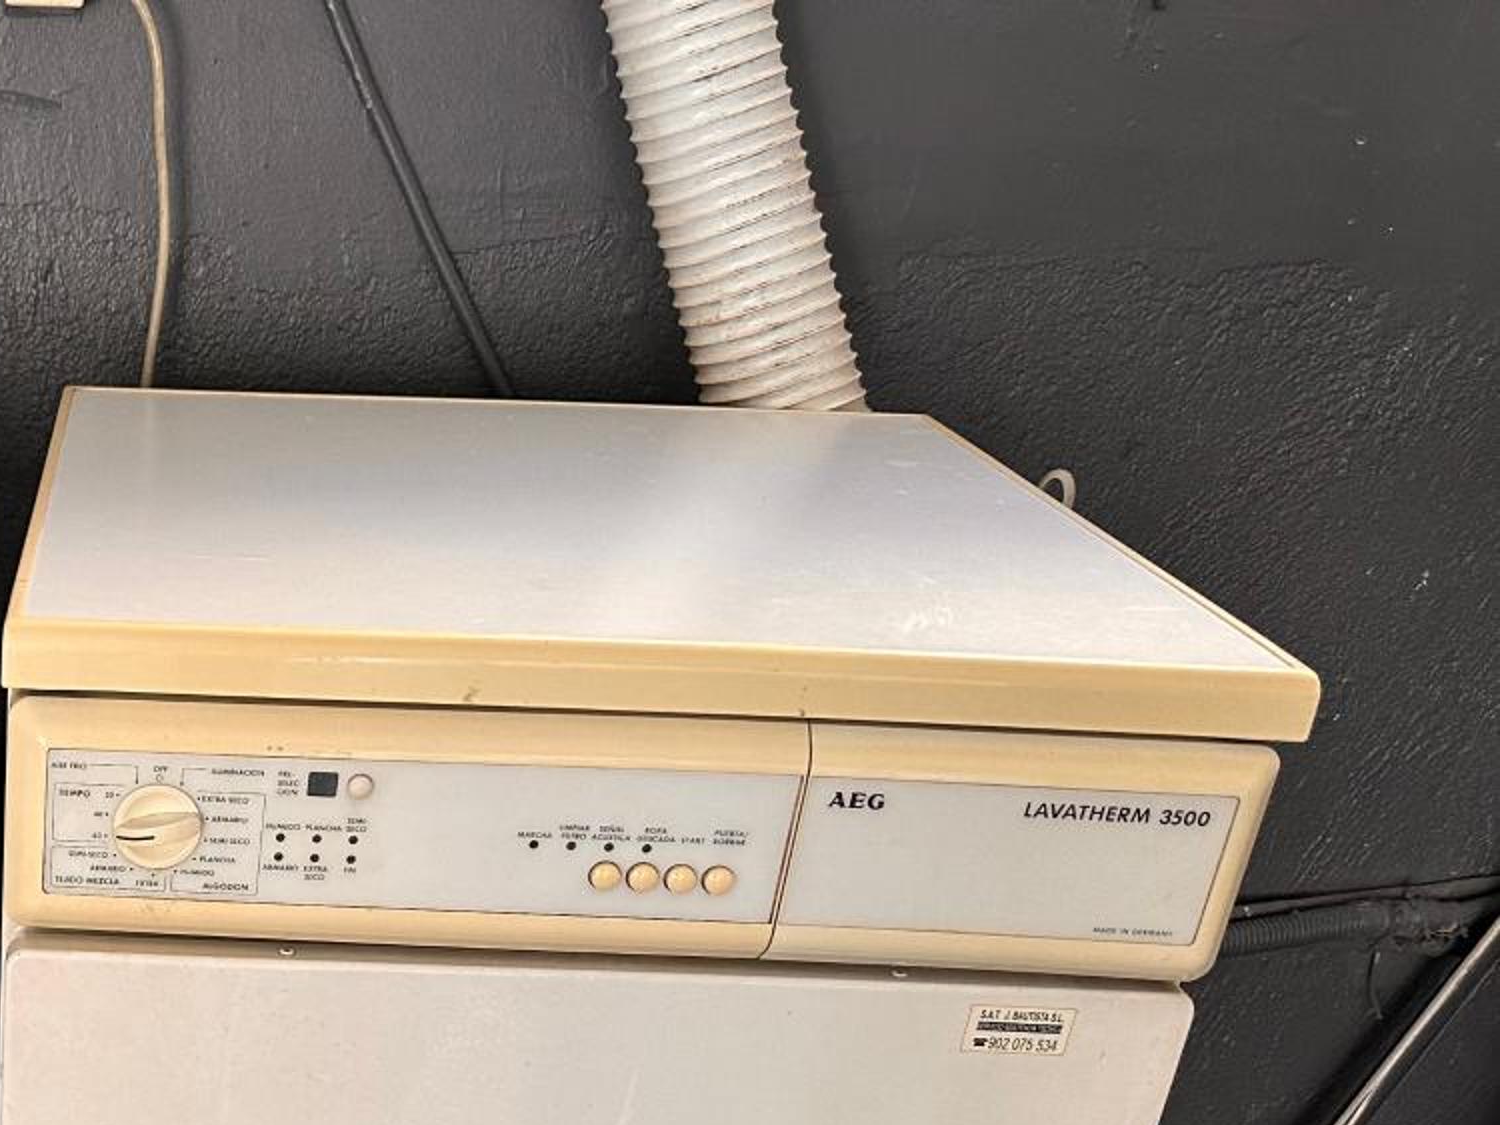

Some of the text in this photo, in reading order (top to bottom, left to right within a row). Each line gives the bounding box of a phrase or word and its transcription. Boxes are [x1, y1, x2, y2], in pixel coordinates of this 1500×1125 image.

[59, 790, 90, 798] TEMPO
[828, 791, 885, 811] AEG
[1023, 802, 1210, 827] LAVATHERM 3500
[1092, 927, 1117, 935] MADE
[1132, 929, 1173, 937] GERMANY
